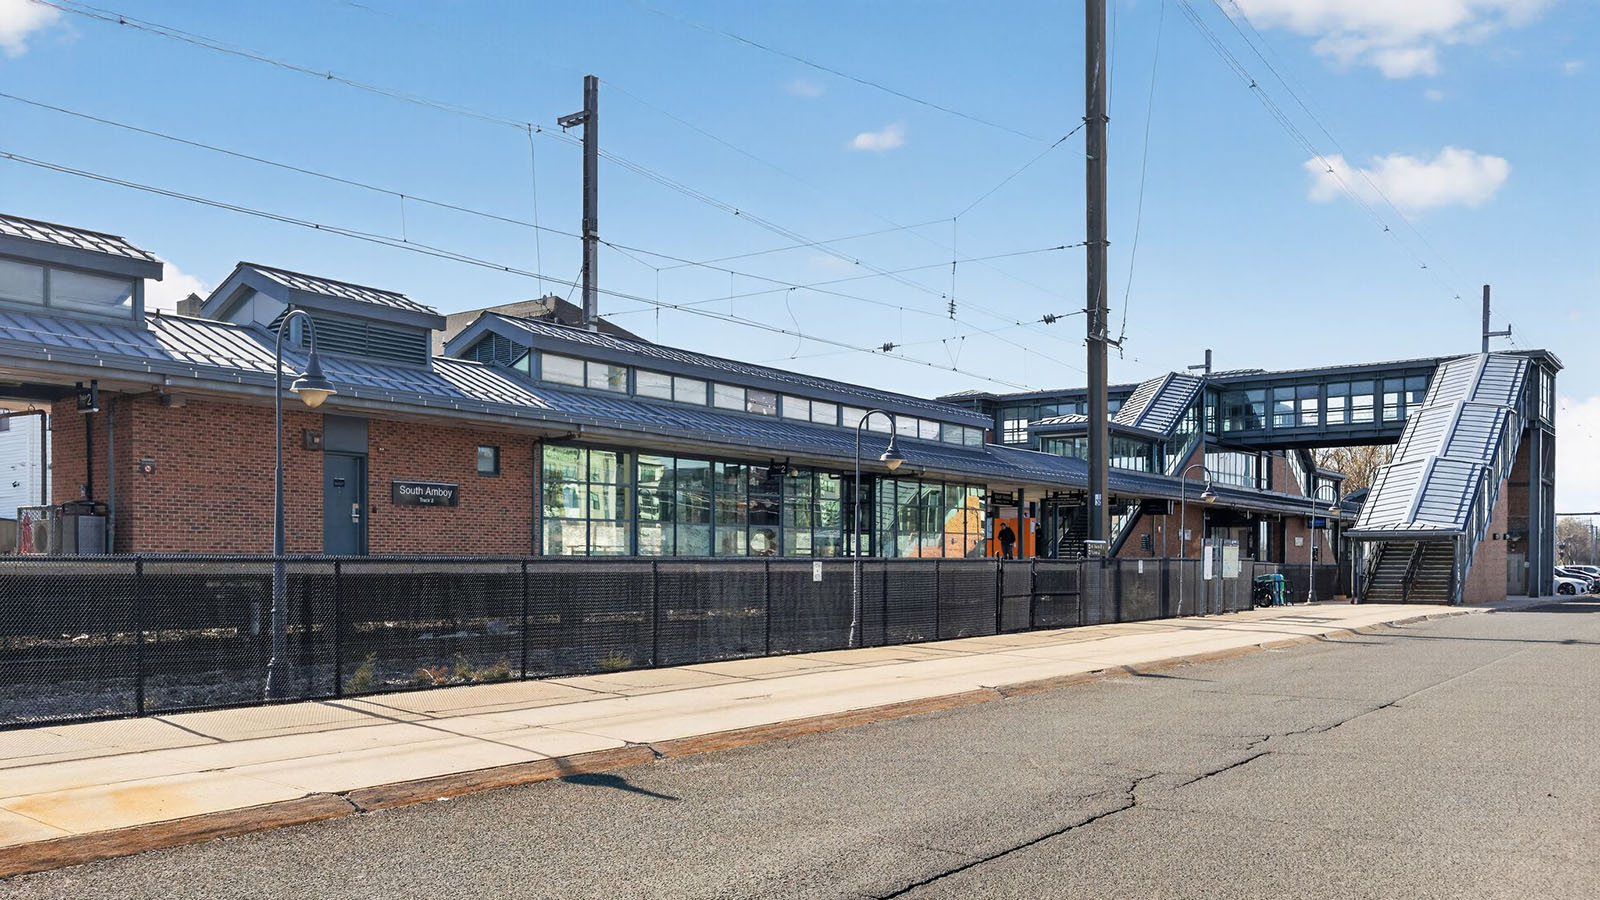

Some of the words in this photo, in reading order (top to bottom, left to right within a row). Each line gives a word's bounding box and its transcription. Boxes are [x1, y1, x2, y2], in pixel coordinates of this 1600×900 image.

[87, 393, 92, 406] 2
[781, 465, 786, 473] 2
[399, 485, 424, 495] South
[425, 486, 452, 498] Amboy
